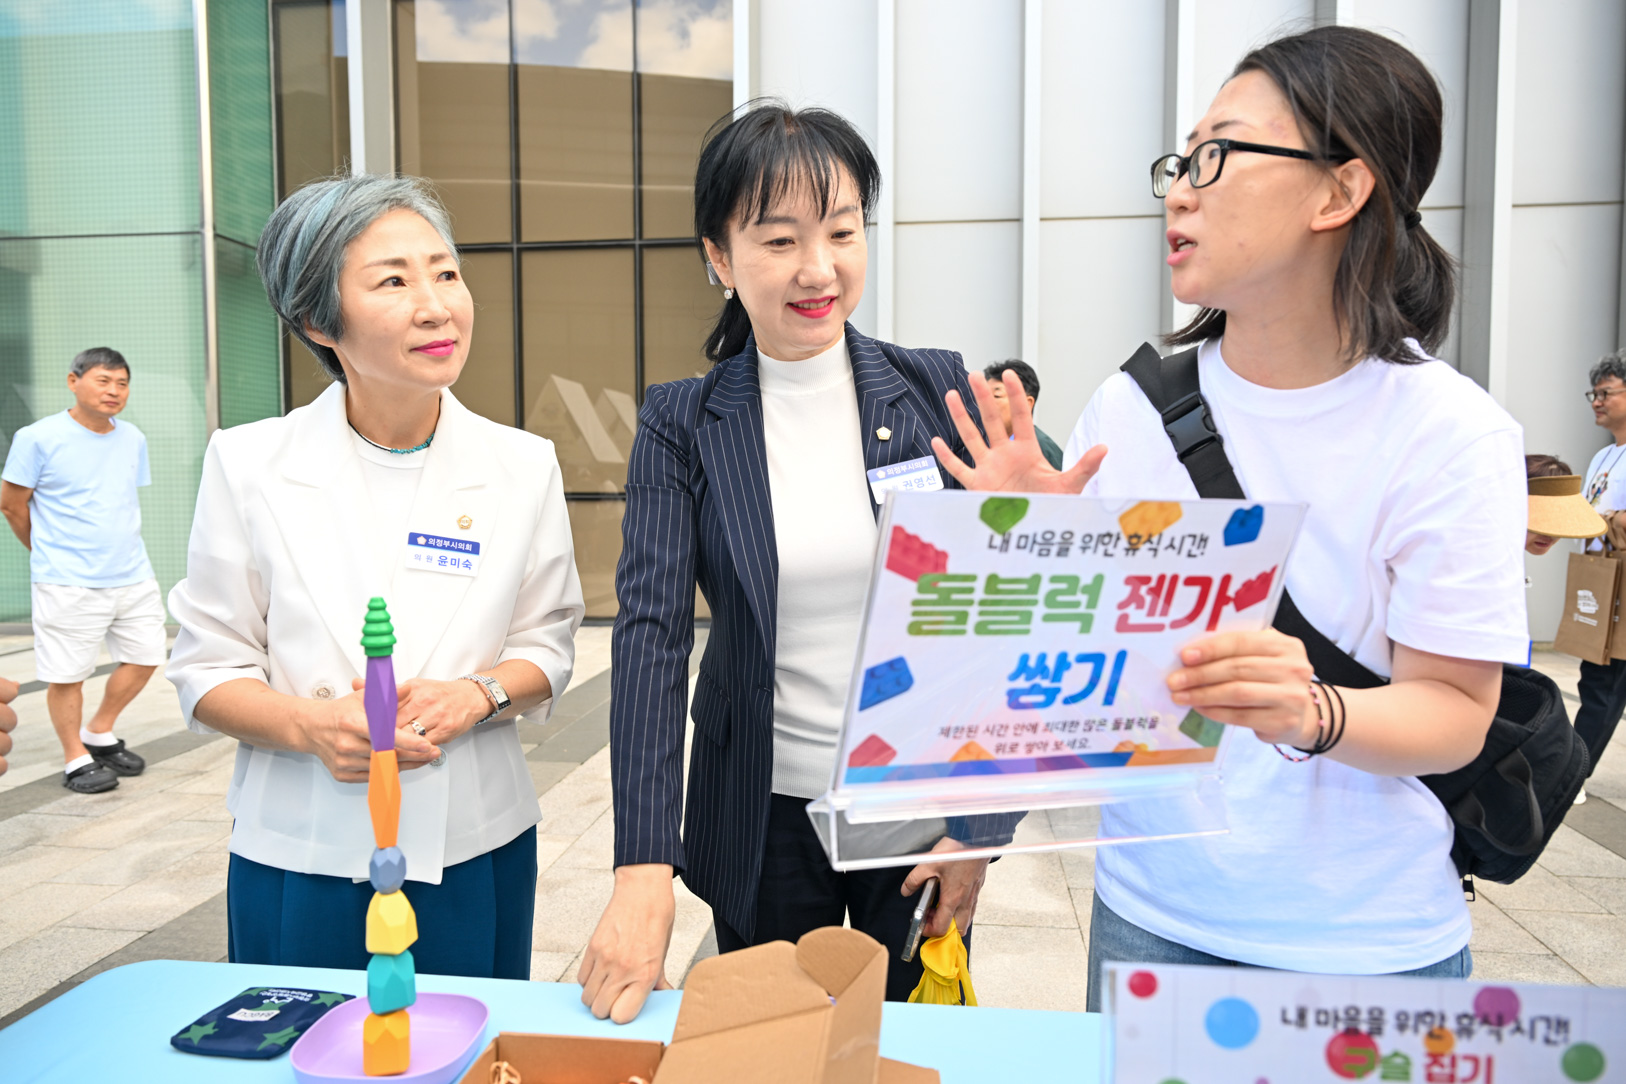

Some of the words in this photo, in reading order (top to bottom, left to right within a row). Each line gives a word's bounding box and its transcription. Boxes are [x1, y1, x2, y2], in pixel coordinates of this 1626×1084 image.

[886, 460, 929, 475] 의정부시의회
[428, 538, 473, 551] 의정부시의회
[987, 531, 1012, 553] 내
[1015, 530, 1075, 558] 마음을
[1079, 531, 1121, 558] 위한
[1123, 532, 1163, 559] 휴식
[1164, 532, 1209, 559] 시간!
[437, 555, 473, 570] 윤미숙
[906, 573, 1105, 636] 돌블럭
[1114, 573, 1234, 633] 젠가
[1005, 649, 1128, 710] 쌓기
[938, 725, 979, 740] 제한된
[982, 724, 1009, 738] 시간
[1013, 721, 1038, 737] 안에
[1083, 718, 1107, 733] 많은
[1111, 716, 1159, 731] 돌블럭을
[994, 742, 1019, 755] 위로
[1281, 1005, 1308, 1030] 내
[1315, 1005, 1386, 1036] 마음을
[1395, 1010, 1448, 1041] 위한
[1454, 1011, 1504, 1042] 휴식
[1343, 1046, 1412, 1082] 구슬
[1424, 1053, 1493, 1084] 집기
